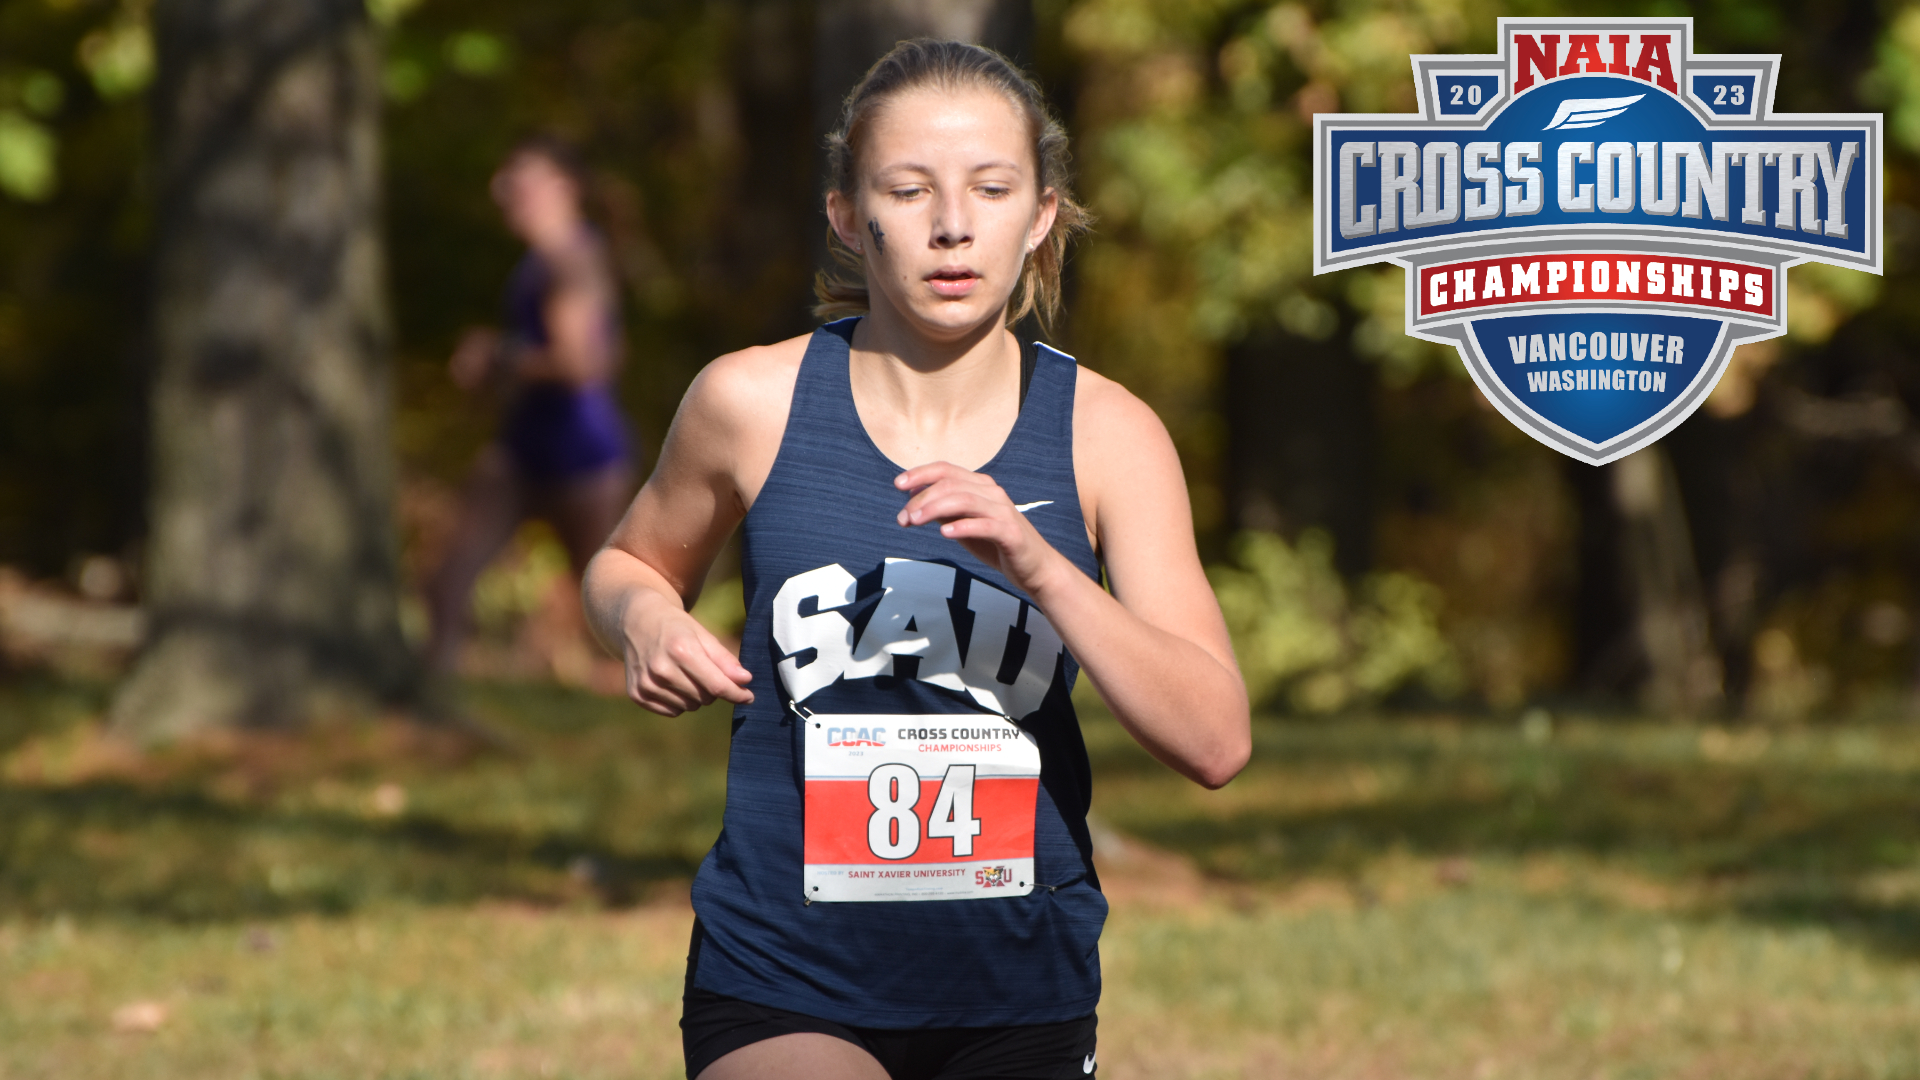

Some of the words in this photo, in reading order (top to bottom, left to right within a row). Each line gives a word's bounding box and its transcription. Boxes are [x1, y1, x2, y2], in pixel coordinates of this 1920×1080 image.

[772, 557, 1064, 721] SAU
[827, 726, 886, 747] CCAC
[897, 728, 948, 740] CROSS
[951, 728, 1020, 740] COUNTRY
[918, 743, 1002, 752] CHAMPIONSHIPS
[867, 762, 982, 861] 84
[848, 870, 875, 879] SAINT
[878, 870, 911, 879] XAVIER
[913, 868, 966, 878] UNIVERSITY
